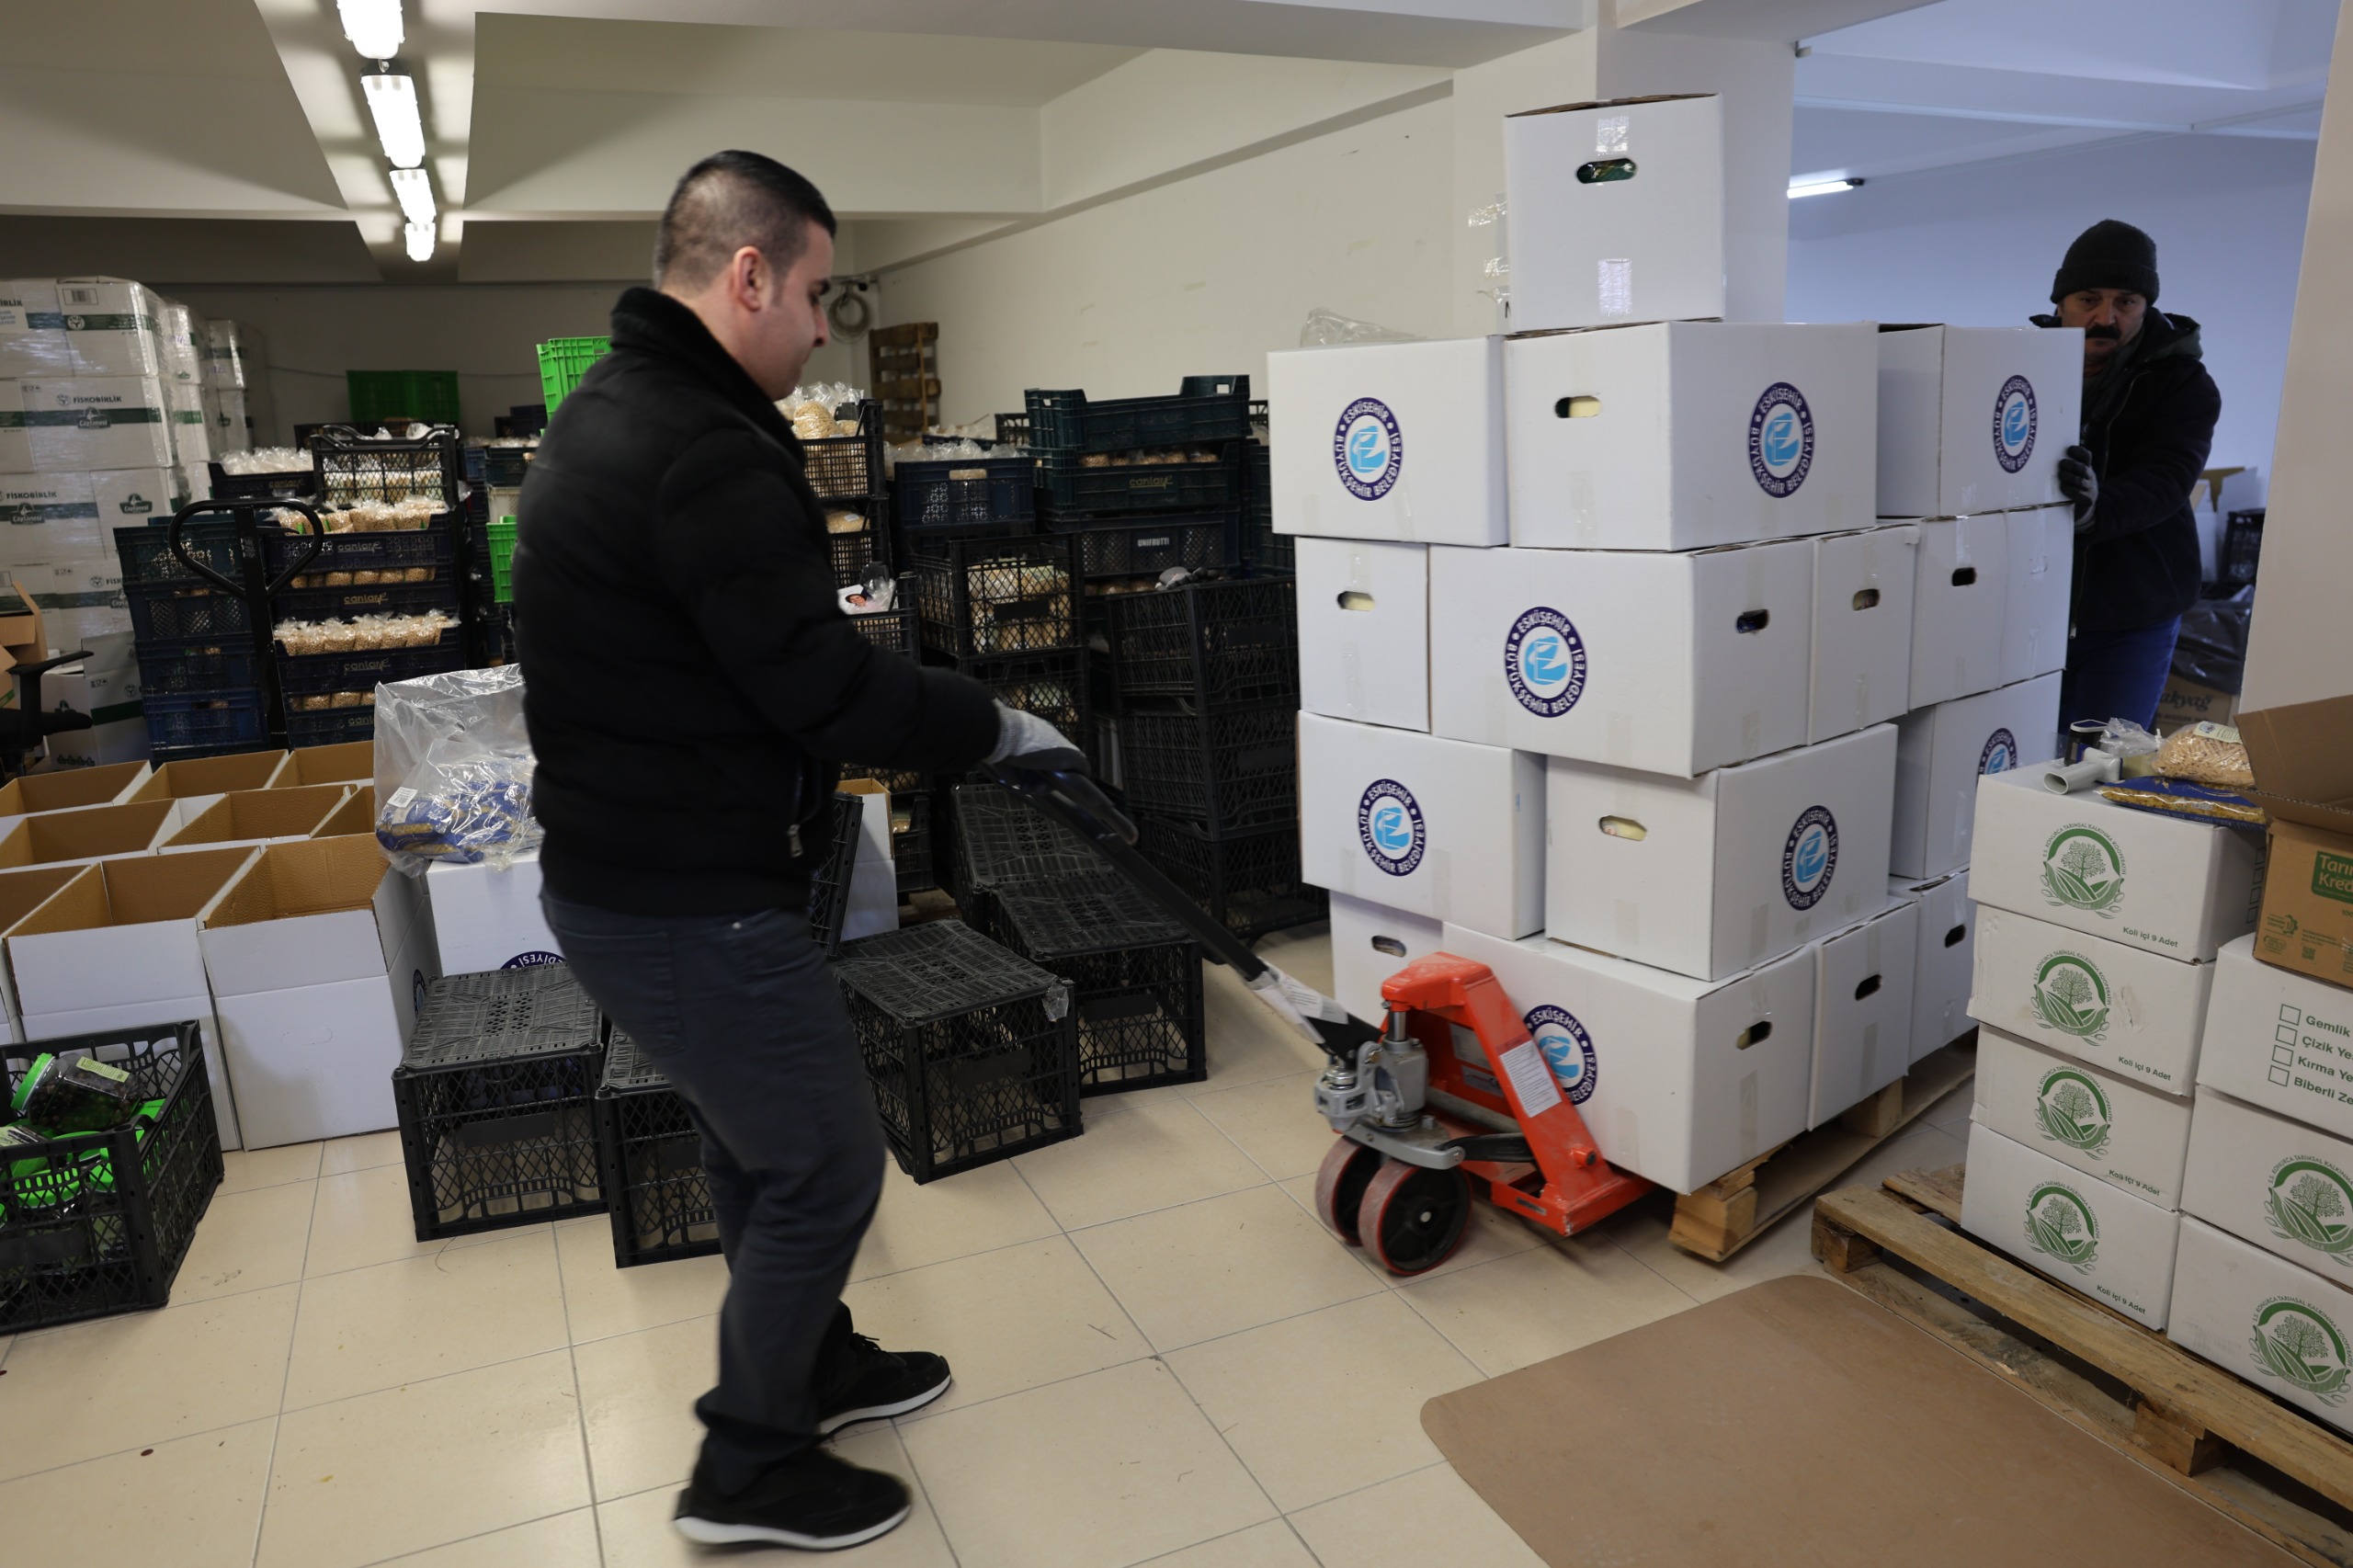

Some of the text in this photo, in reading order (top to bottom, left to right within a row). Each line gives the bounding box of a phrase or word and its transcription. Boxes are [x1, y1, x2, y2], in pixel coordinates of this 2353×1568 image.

[1343, 400, 1389, 424] ESKİŞEHİR
[1758, 387, 1803, 413] ESKİŞEHİR
[1516, 609, 1571, 636] ESKİŞEHİR
[1506, 643, 1549, 714] BÜYÜKŞEHİR
[1367, 781, 1413, 806] ESKİŞEHİR
[2122, 926, 2139, 937] Koli
[2158, 937, 2178, 948] Adet
[1529, 1007, 1583, 1038] ESKİŞEHİR
[2305, 1016, 2351, 1038] Gemlik
[2302, 1036, 2353, 1060] Çizik Ye
[2118, 1056, 2133, 1066] Koli
[2153, 1069, 2171, 1081] Adet
[2298, 1056, 2336, 1076] Kırma
[2293, 1076, 2336, 1098] Biberli
[2109, 1169, 2123, 1180] Koli
[2142, 1184, 2160, 1196] Adet
[2097, 1285, 2111, 1296] Koli
[2128, 1301, 2146, 1314] Adet
